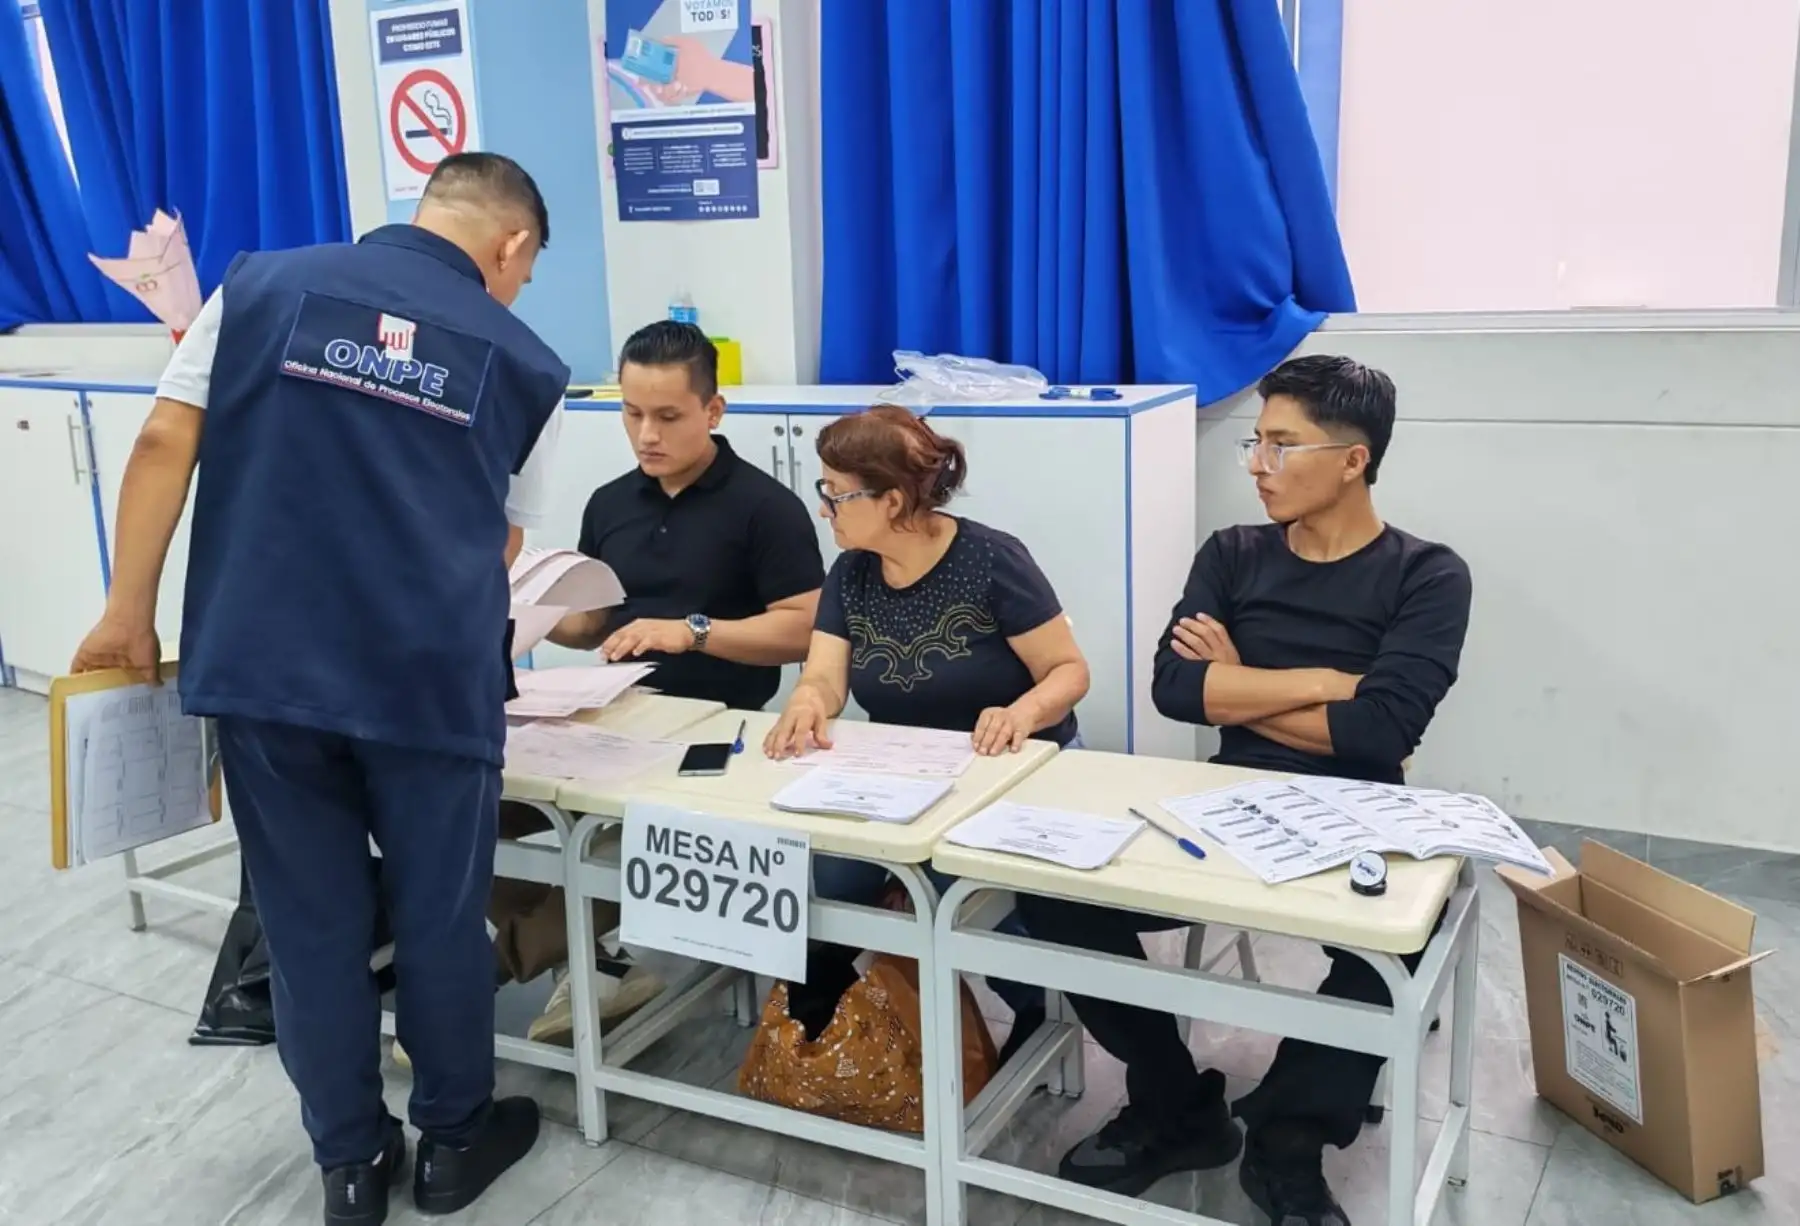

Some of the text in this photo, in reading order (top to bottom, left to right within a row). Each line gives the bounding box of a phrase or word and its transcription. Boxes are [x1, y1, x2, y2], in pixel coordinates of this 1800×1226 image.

[691, 8, 731, 22] TODS!
[284, 359, 471, 420] Oficina Nacional de Procesos Electorales
[324, 338, 449, 398] ONPE
[646, 824, 740, 871] MESA
[626, 857, 800, 933] 029720
